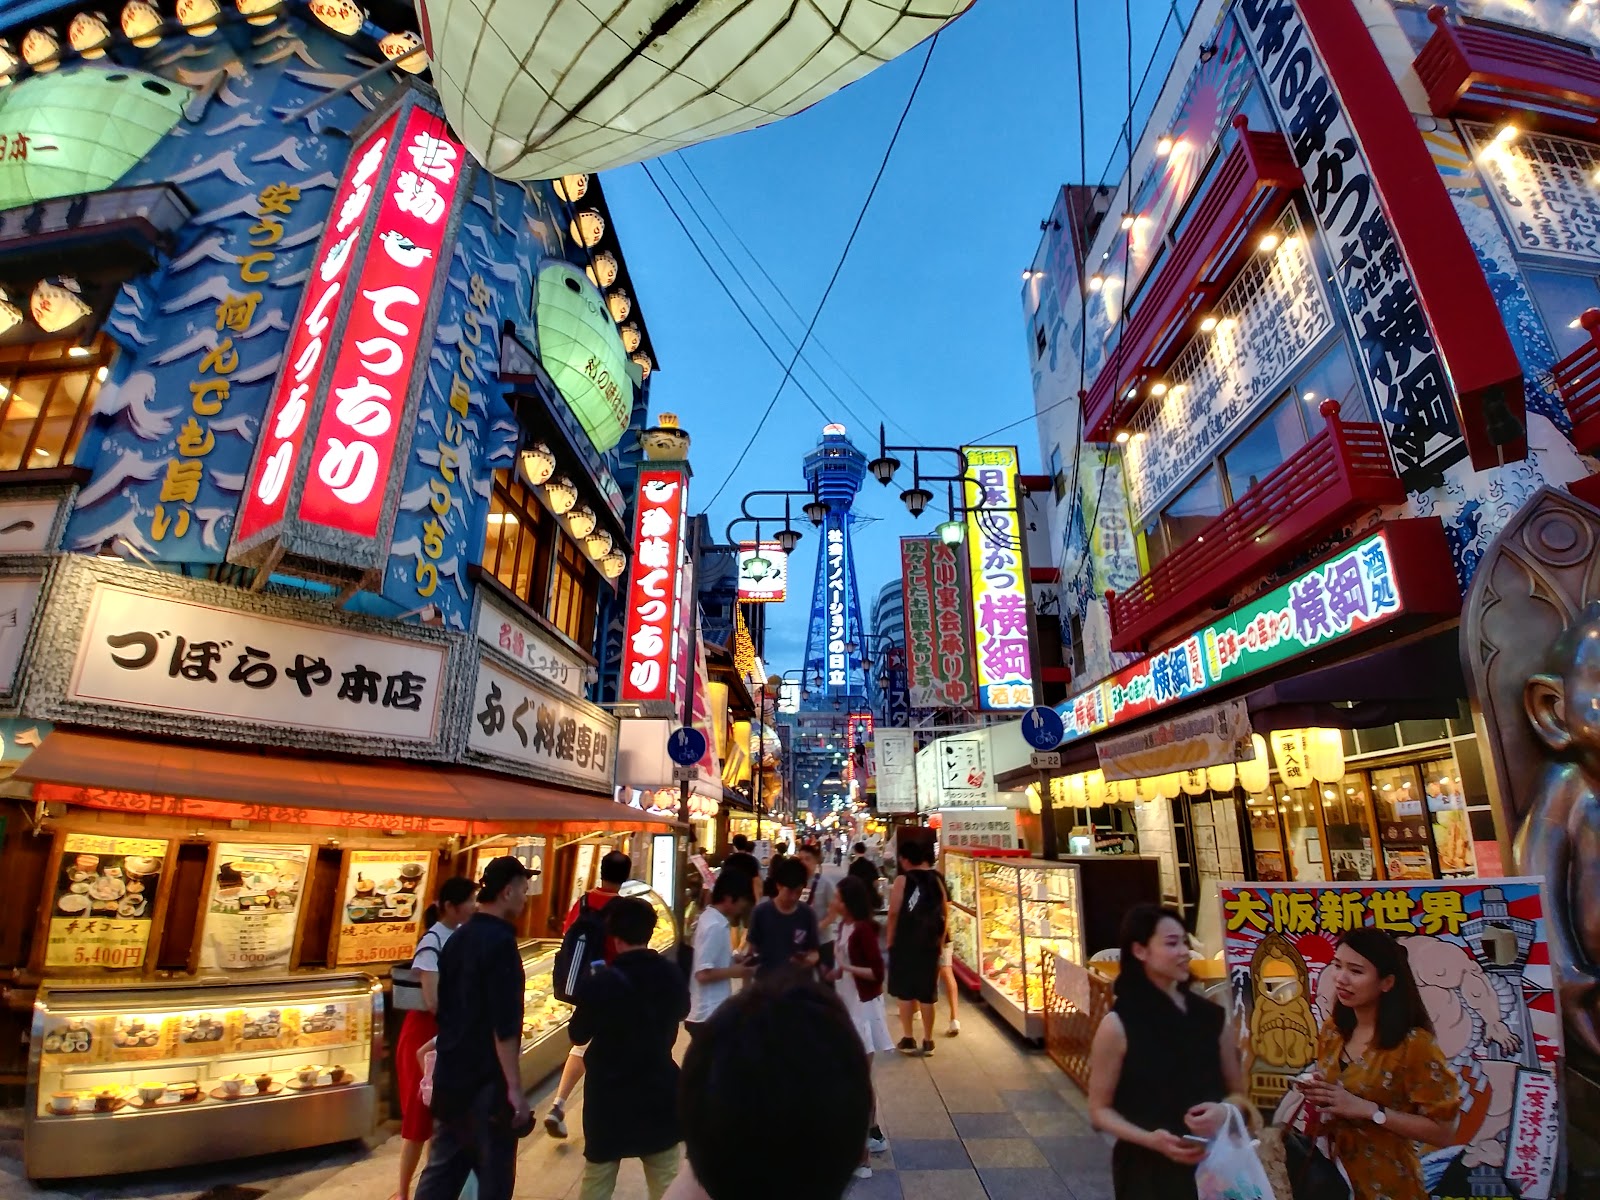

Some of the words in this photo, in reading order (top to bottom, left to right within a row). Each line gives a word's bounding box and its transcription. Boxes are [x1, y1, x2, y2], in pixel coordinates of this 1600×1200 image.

[151, 180, 301, 541] 安うて何んでも旨い
[1360, 278, 1470, 483] 横綱
[966, 450, 1014, 467] 新世界
[978, 468, 1017, 590] 日本の串かつ
[933, 542, 967, 703] 大小宴会承り中
[1291, 556, 1369, 643] 横綱
[1362, 542, 1396, 612] 酒処
[106, 628, 427, 712] づぼらや本店
[979, 593, 1032, 682] 横綱
[1152, 646, 1191, 701] 横綱
[476, 680, 608, 773] ふぐ料理専門
[990, 686, 1032, 705] 酒処
[1280, 734, 1303, 777] 一串入魂
[1224, 889, 1469, 935] 大阪新世界
